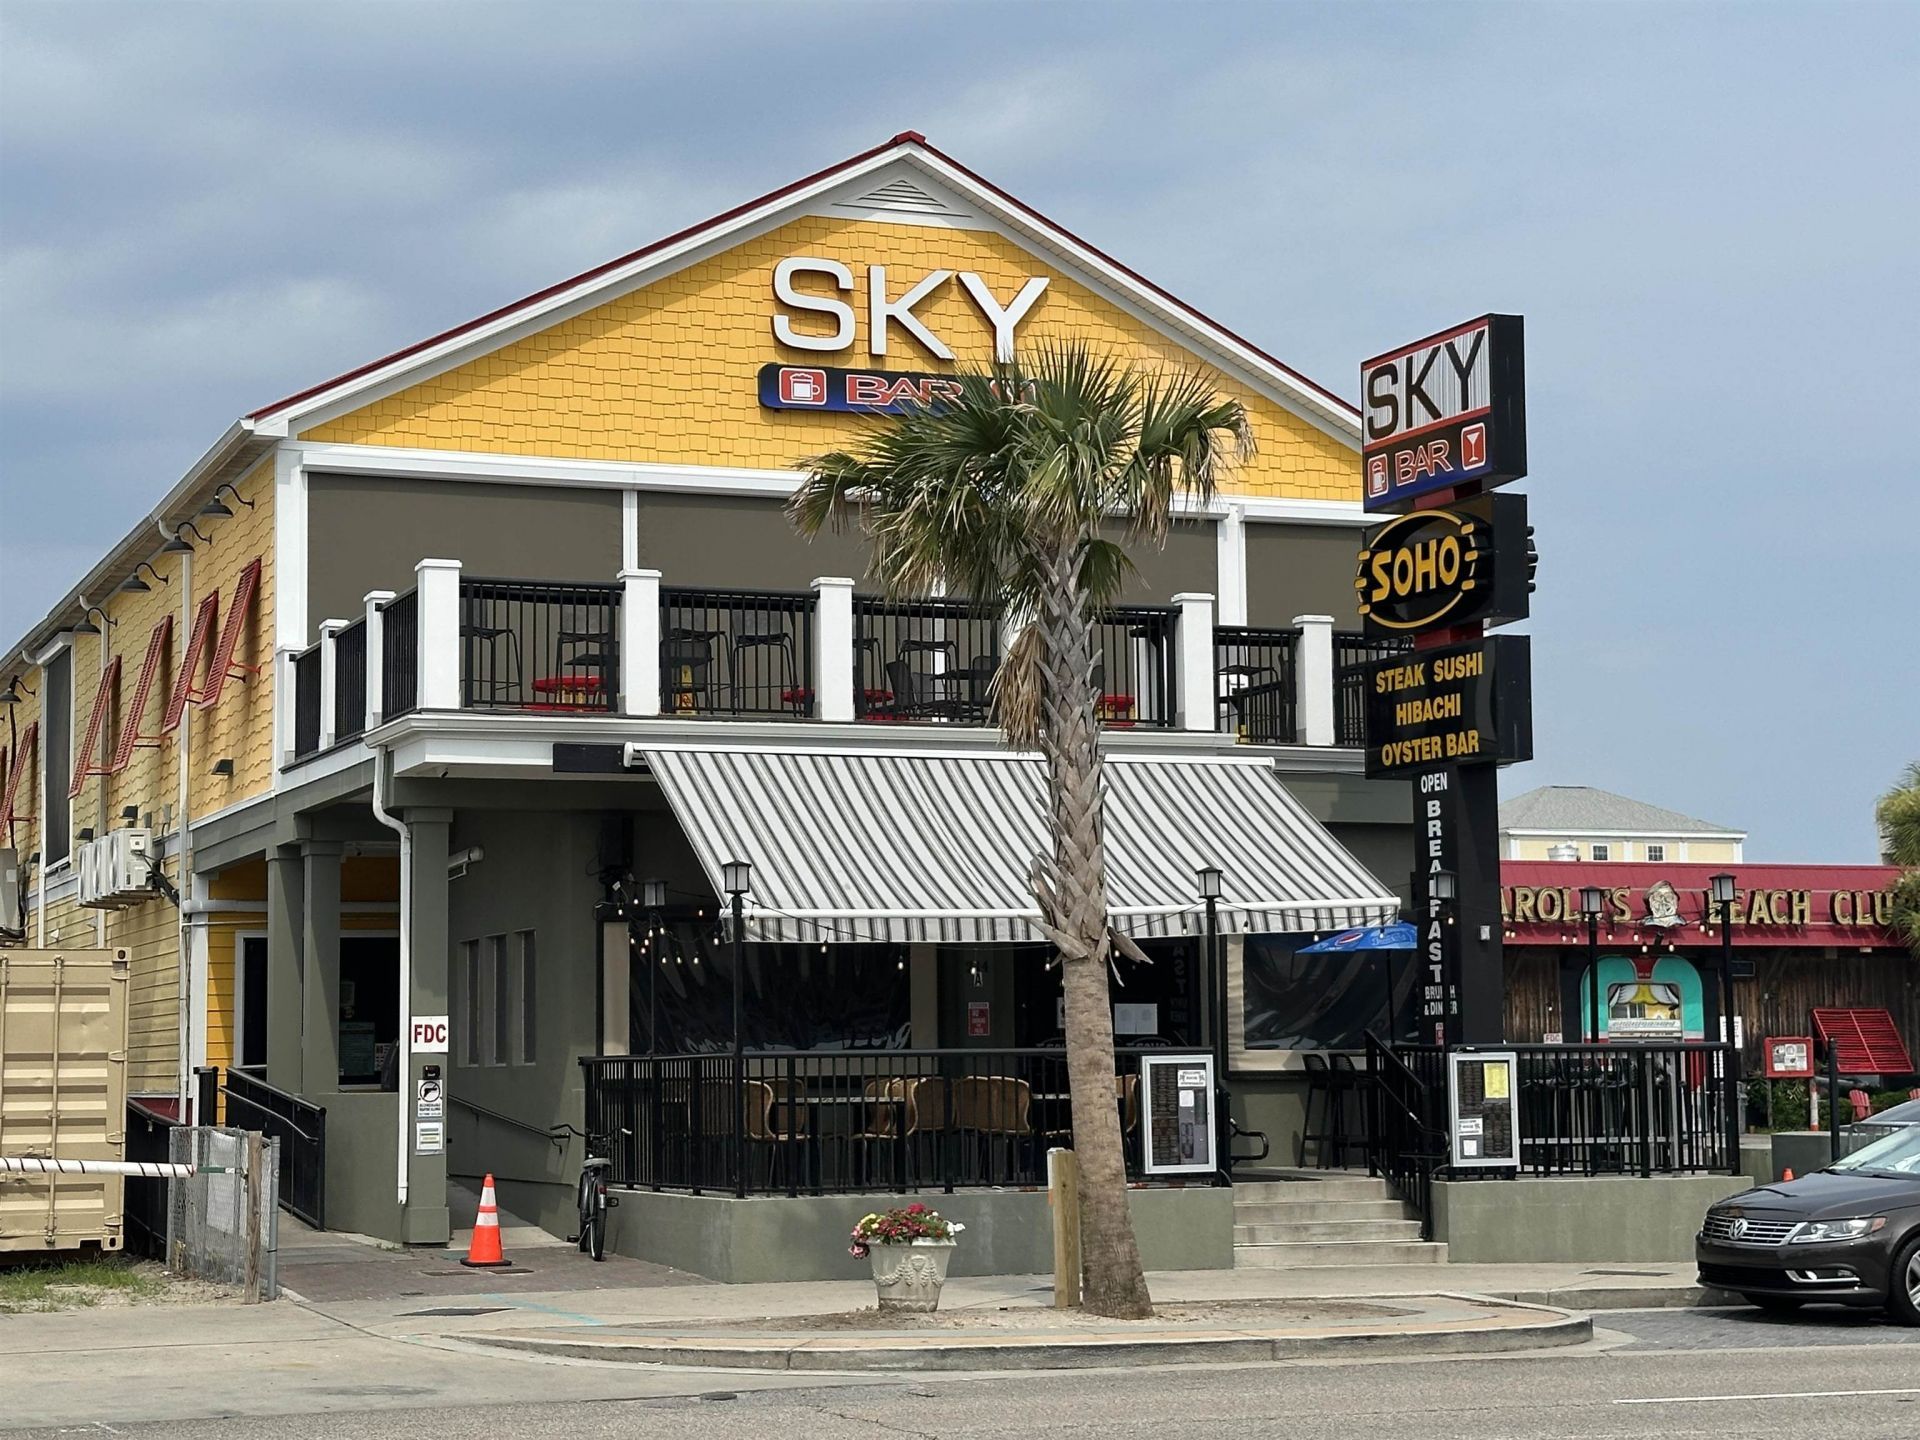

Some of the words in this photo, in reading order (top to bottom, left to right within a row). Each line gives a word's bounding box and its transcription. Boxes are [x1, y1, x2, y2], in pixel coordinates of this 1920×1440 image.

[772, 257, 1050, 363] SKY
[846, 374, 967, 410] BAR
[1367, 329, 1485, 440] SKY
[1395, 439, 1453, 487] BAR
[1371, 535, 1460, 603] SOHO
[1376, 662, 1425, 693] STEAK
[1433, 651, 1483, 682] SUSHI
[1396, 693, 1461, 726] HIBACHI
[1381, 735, 1442, 767] OYSTER
[1446, 729, 1479, 758] BAR
[1420, 772, 1448, 794] OPEN
[1834, 890, 1894, 925] CLU
[1424, 985, 1456, 1000] BRUH
[1430, 1001, 1457, 1015] DINR
[414, 1024, 446, 1043] FDC
